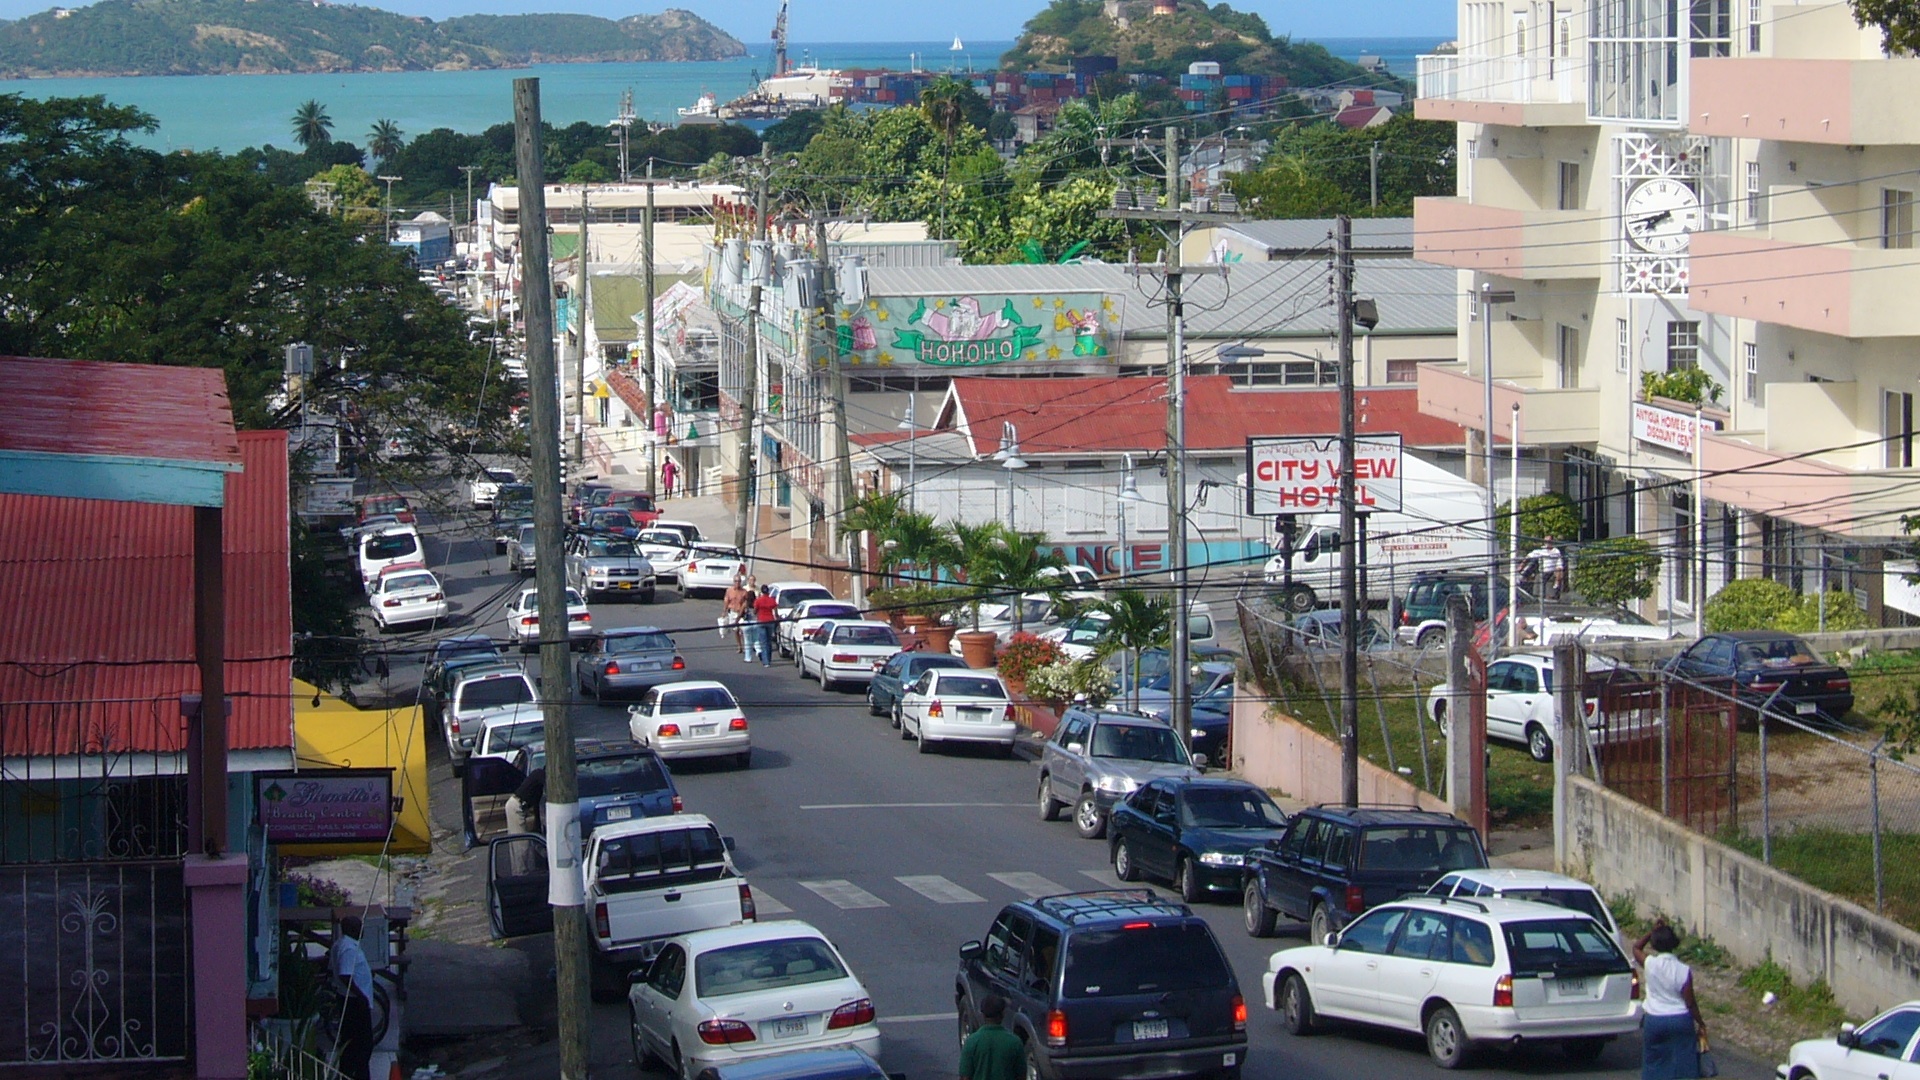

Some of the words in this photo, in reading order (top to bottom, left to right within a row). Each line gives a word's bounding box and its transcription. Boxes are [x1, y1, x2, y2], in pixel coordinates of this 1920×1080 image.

[920, 340, 1013, 363] HOHOHO
[1256, 459, 1319, 482] CITY
[1326, 458, 1397, 480] VEW
[1279, 485, 1376, 508] HOTL
